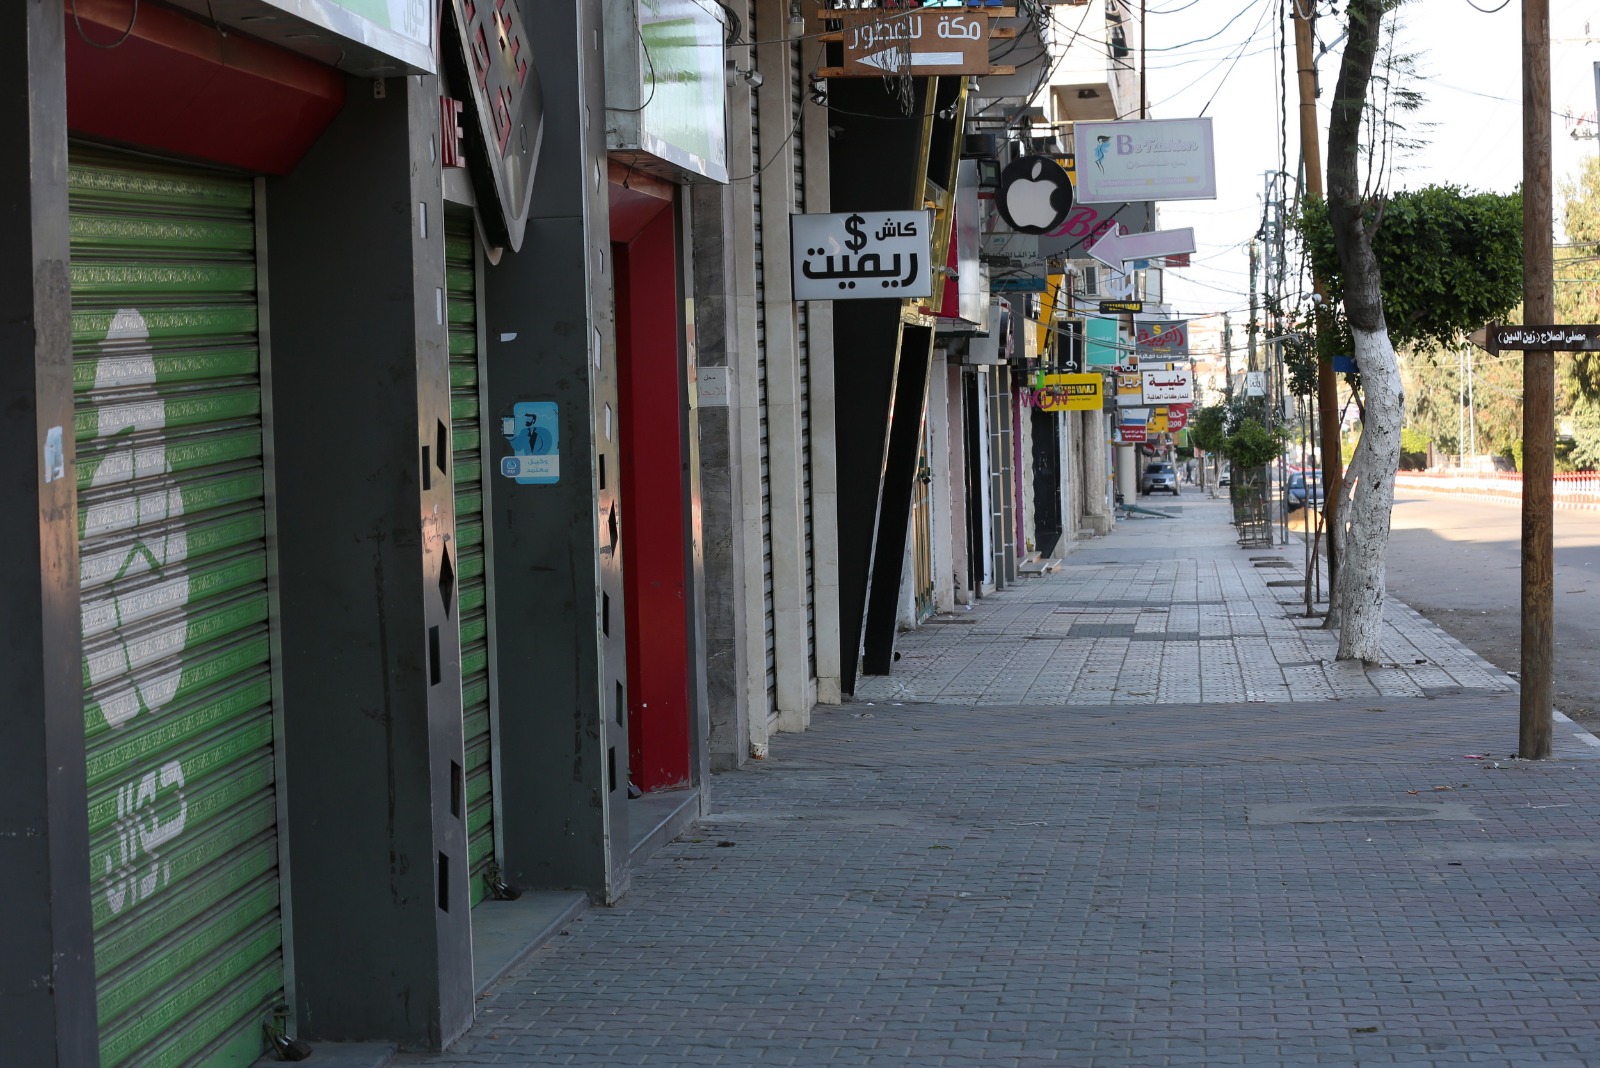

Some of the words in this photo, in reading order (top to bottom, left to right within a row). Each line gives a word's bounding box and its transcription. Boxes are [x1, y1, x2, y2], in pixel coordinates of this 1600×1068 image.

[937, 15, 981, 40] مكة
[844, 213, 867, 254] $
[875, 217, 917, 241] كاش
[802, 247, 918, 290] ريميت
[1147, 373, 1187, 391] طيبة
